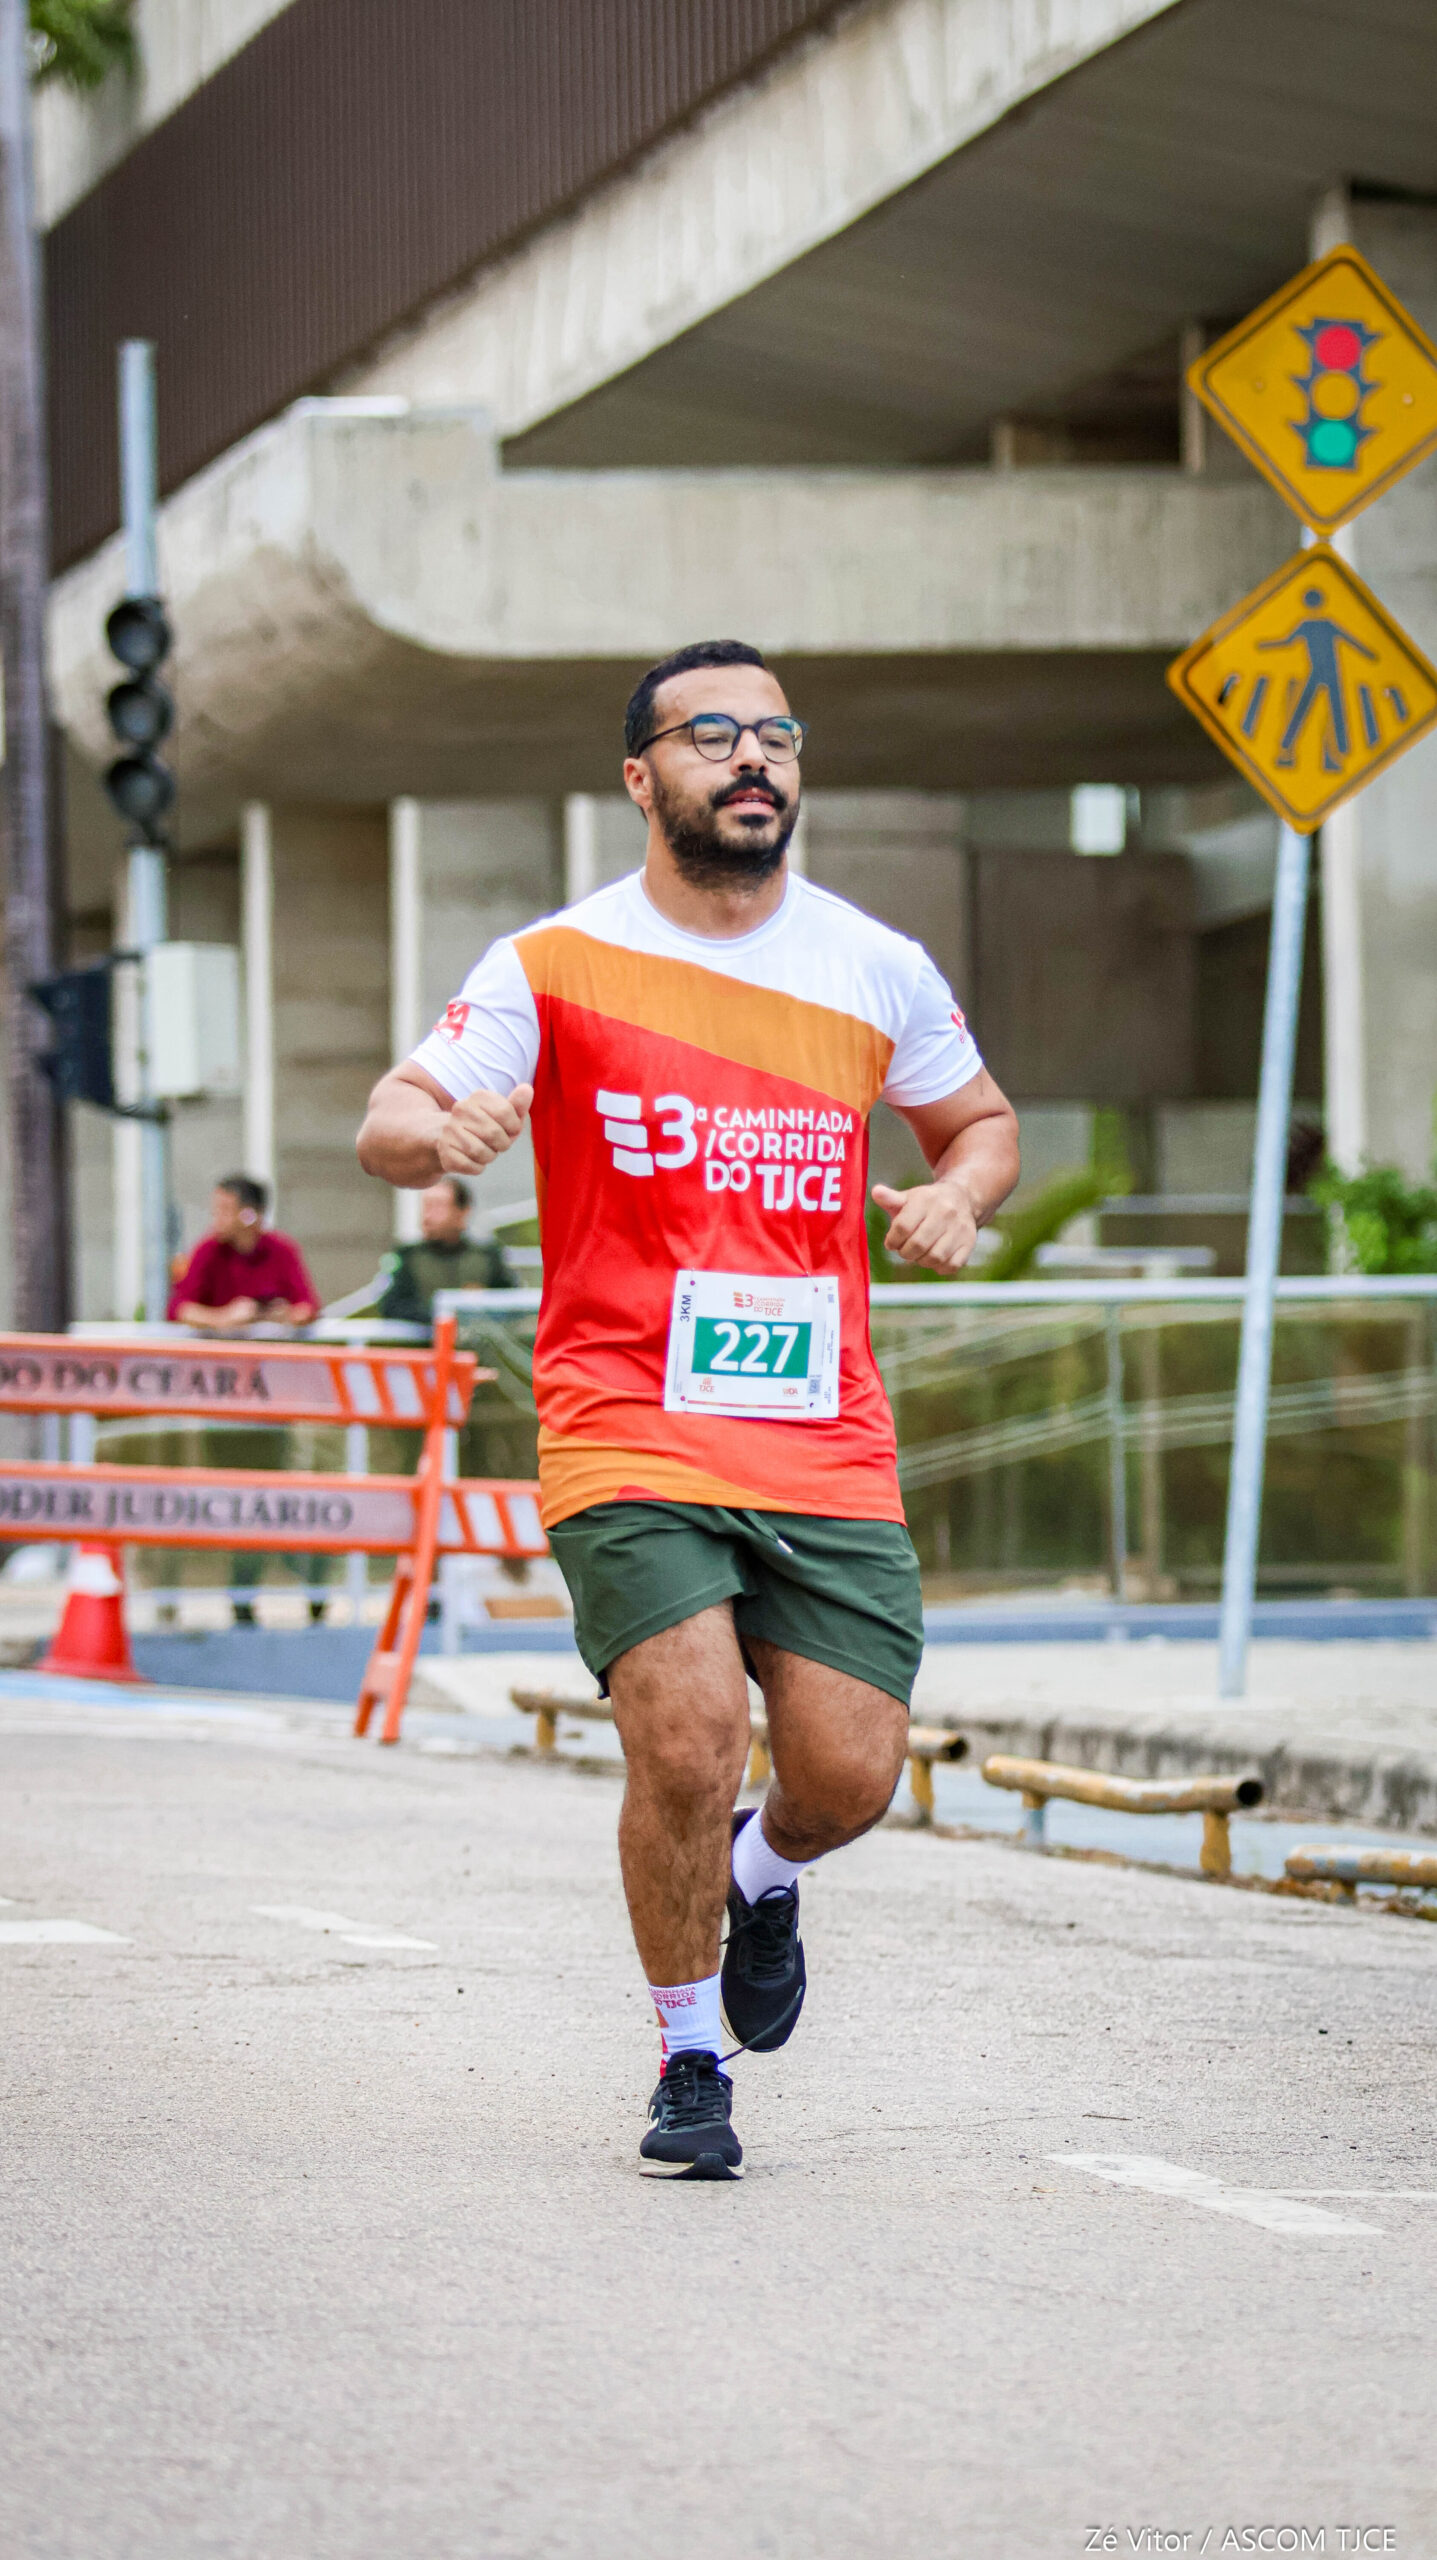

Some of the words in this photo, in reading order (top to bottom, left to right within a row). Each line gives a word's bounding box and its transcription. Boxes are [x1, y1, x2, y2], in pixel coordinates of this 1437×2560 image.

[714, 1107, 853, 1133] CAMINHADA
[705, 1129, 845, 1162] /CORRIDA
[705, 1160, 751, 1192] DO
[755, 1164, 842, 1211] TJCE
[680, 1294, 692, 1322] 3KM
[764, 1307, 784, 1316] TJCE
[710, 1322, 799, 1373] 227
[54, 1358, 119, 1394] DO
[662, 1996, 698, 2008] TJCE
